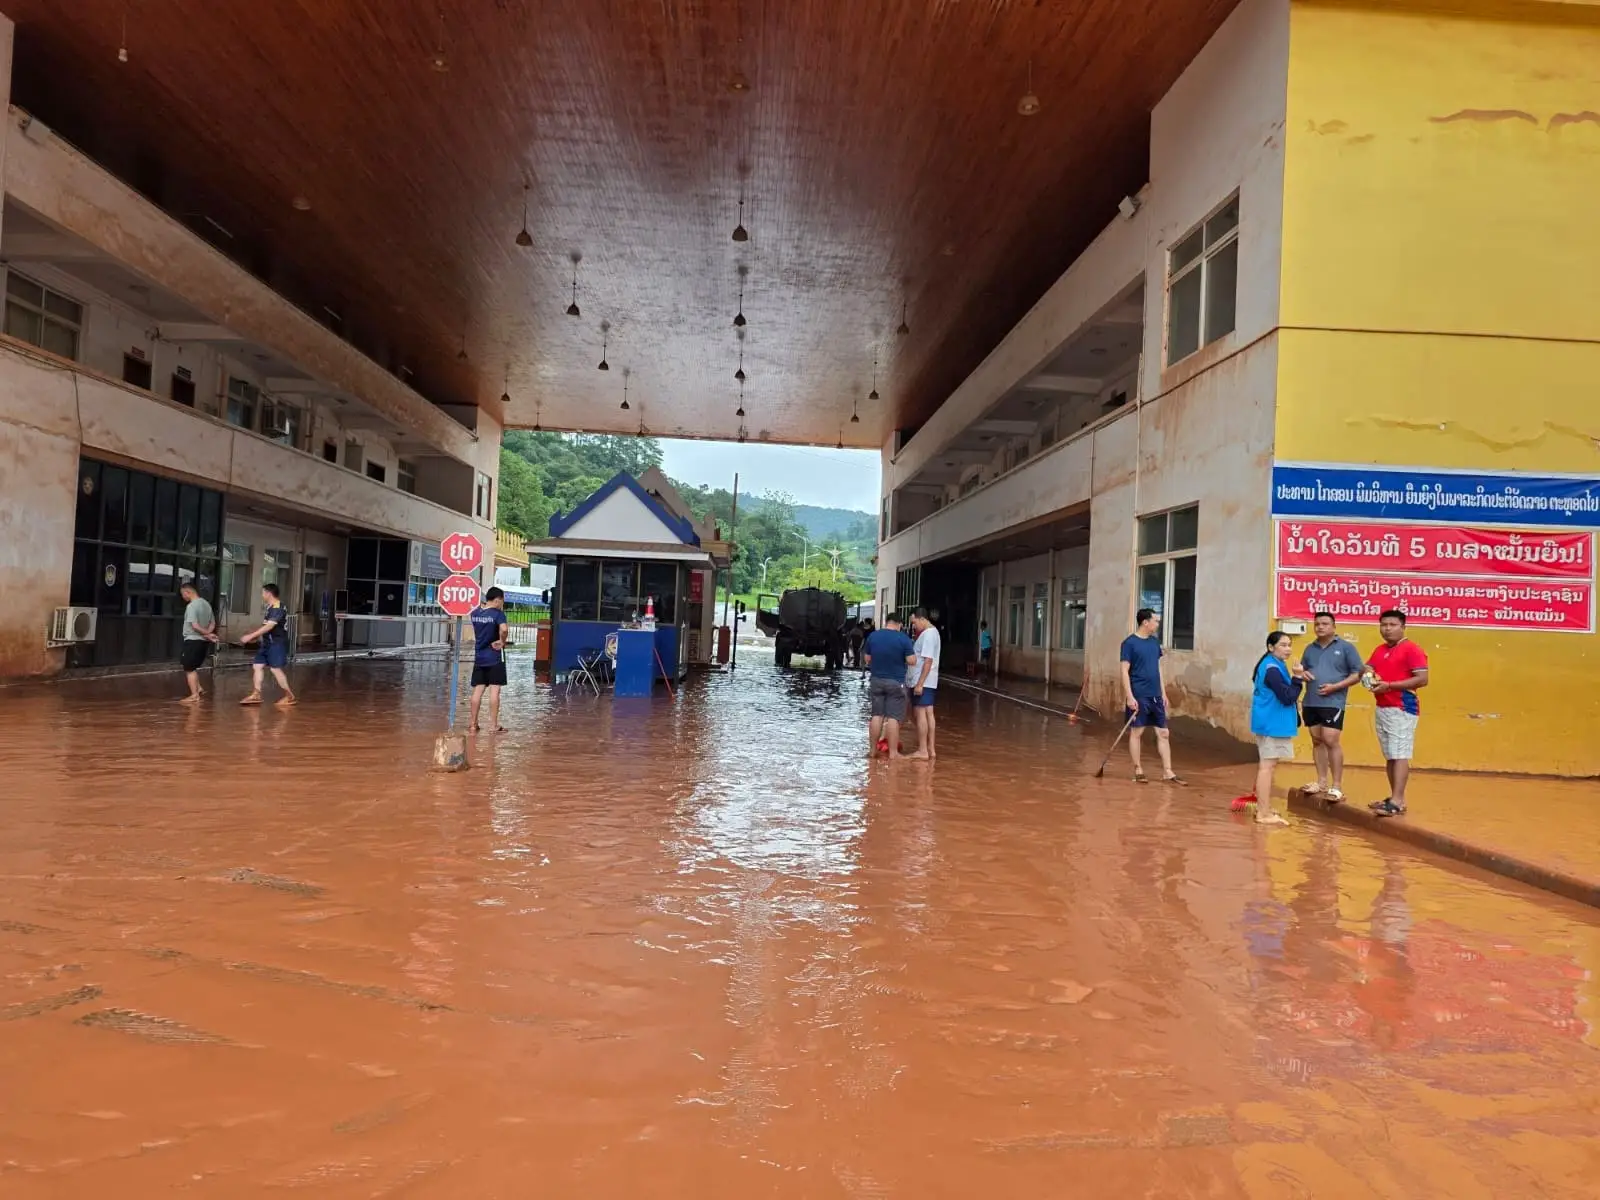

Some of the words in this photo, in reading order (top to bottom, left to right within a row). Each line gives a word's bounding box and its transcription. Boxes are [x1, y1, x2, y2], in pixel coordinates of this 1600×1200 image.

[1277, 484, 1315, 501] ປະທານ
[1316, 479, 1353, 502] ໄກສອນ
[450, 541, 474, 566] ຢຸດ
[1409, 537, 1426, 558] 5
[443, 586, 475, 602] STOP
[1457, 607, 1488, 619] ແລະ
